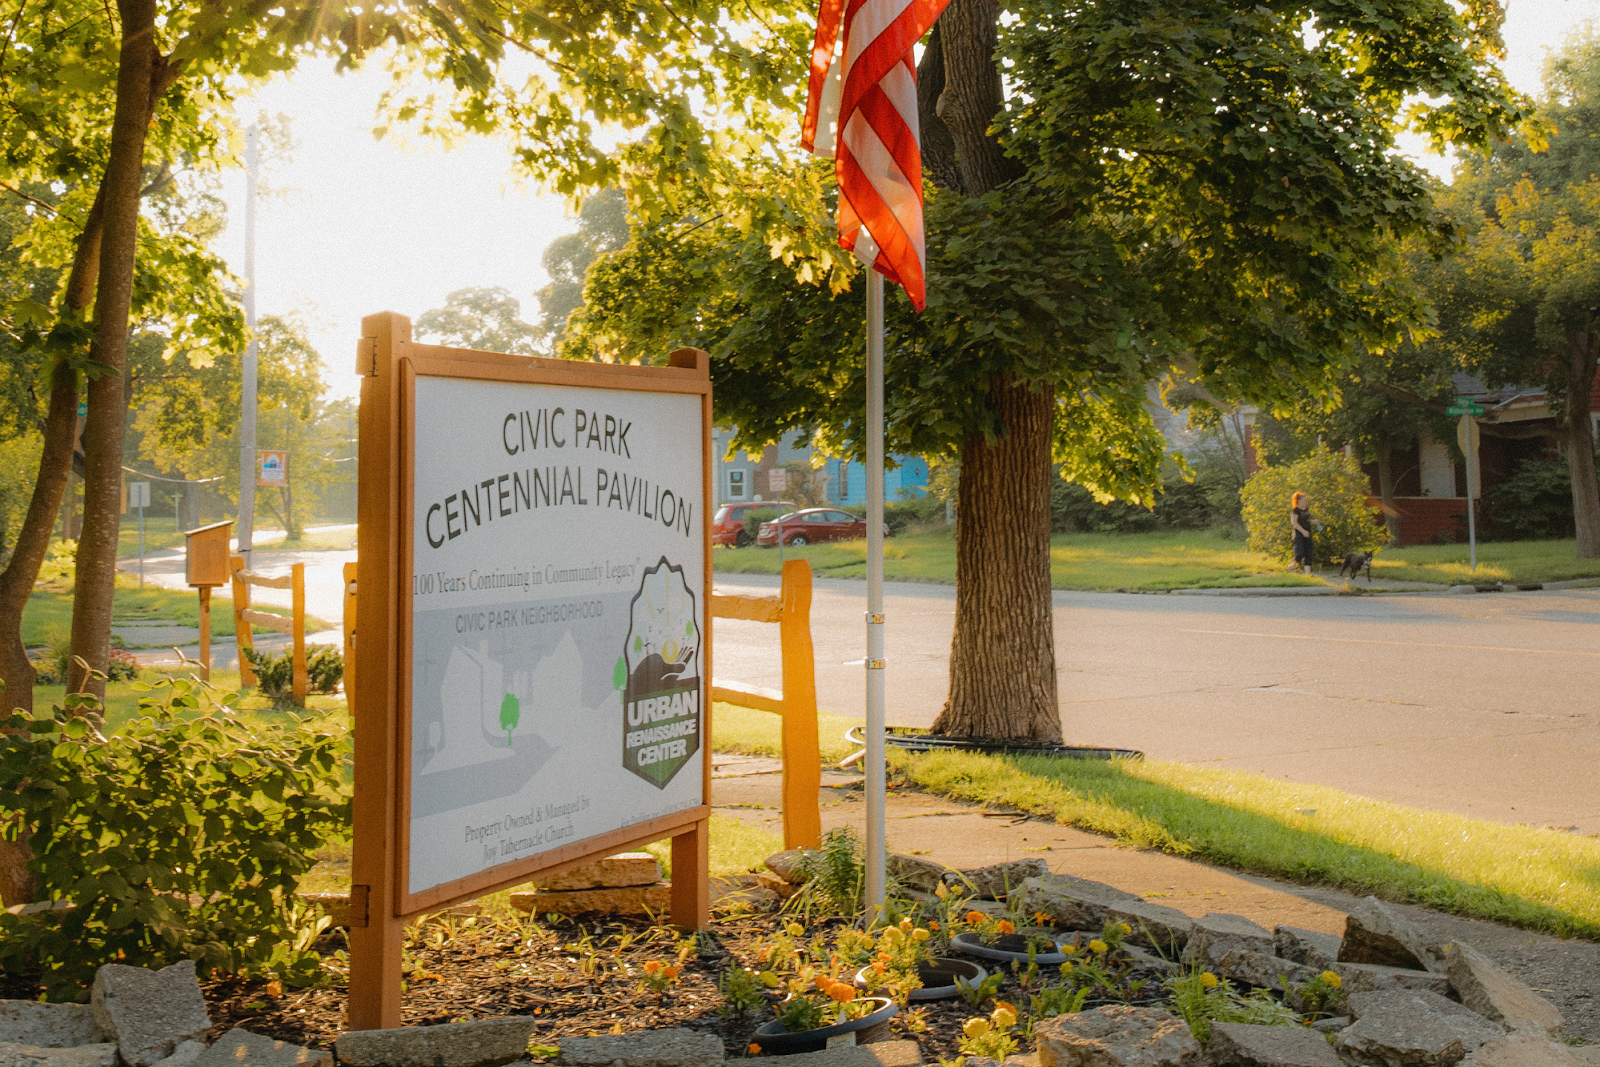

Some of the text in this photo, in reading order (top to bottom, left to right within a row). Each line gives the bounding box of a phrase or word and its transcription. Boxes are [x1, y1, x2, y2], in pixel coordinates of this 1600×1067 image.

[503, 407, 632, 459] CIVIC PARK
[426, 466, 692, 549] CENTENNIAL PAVILION
[437, 572, 466, 593] Years
[469, 569, 530, 592] Continuing
[532, 565, 543, 585] in
[545, 562, 603, 586] Community
[456, 600, 603, 634] CIVIC PARK NEIGHBORHOOD
[628, 690, 698, 727] URBAN
[626, 719, 696, 749] RENAISSANCE
[637, 739, 687, 767] CENTER
[464, 822, 502, 843] Property
[504, 810, 534, 831] Owned
[535, 806, 544, 823] &
[545, 796, 580, 819] Managed
[500, 832, 543, 856] Tabernacle
[545, 820, 574, 843] Church
